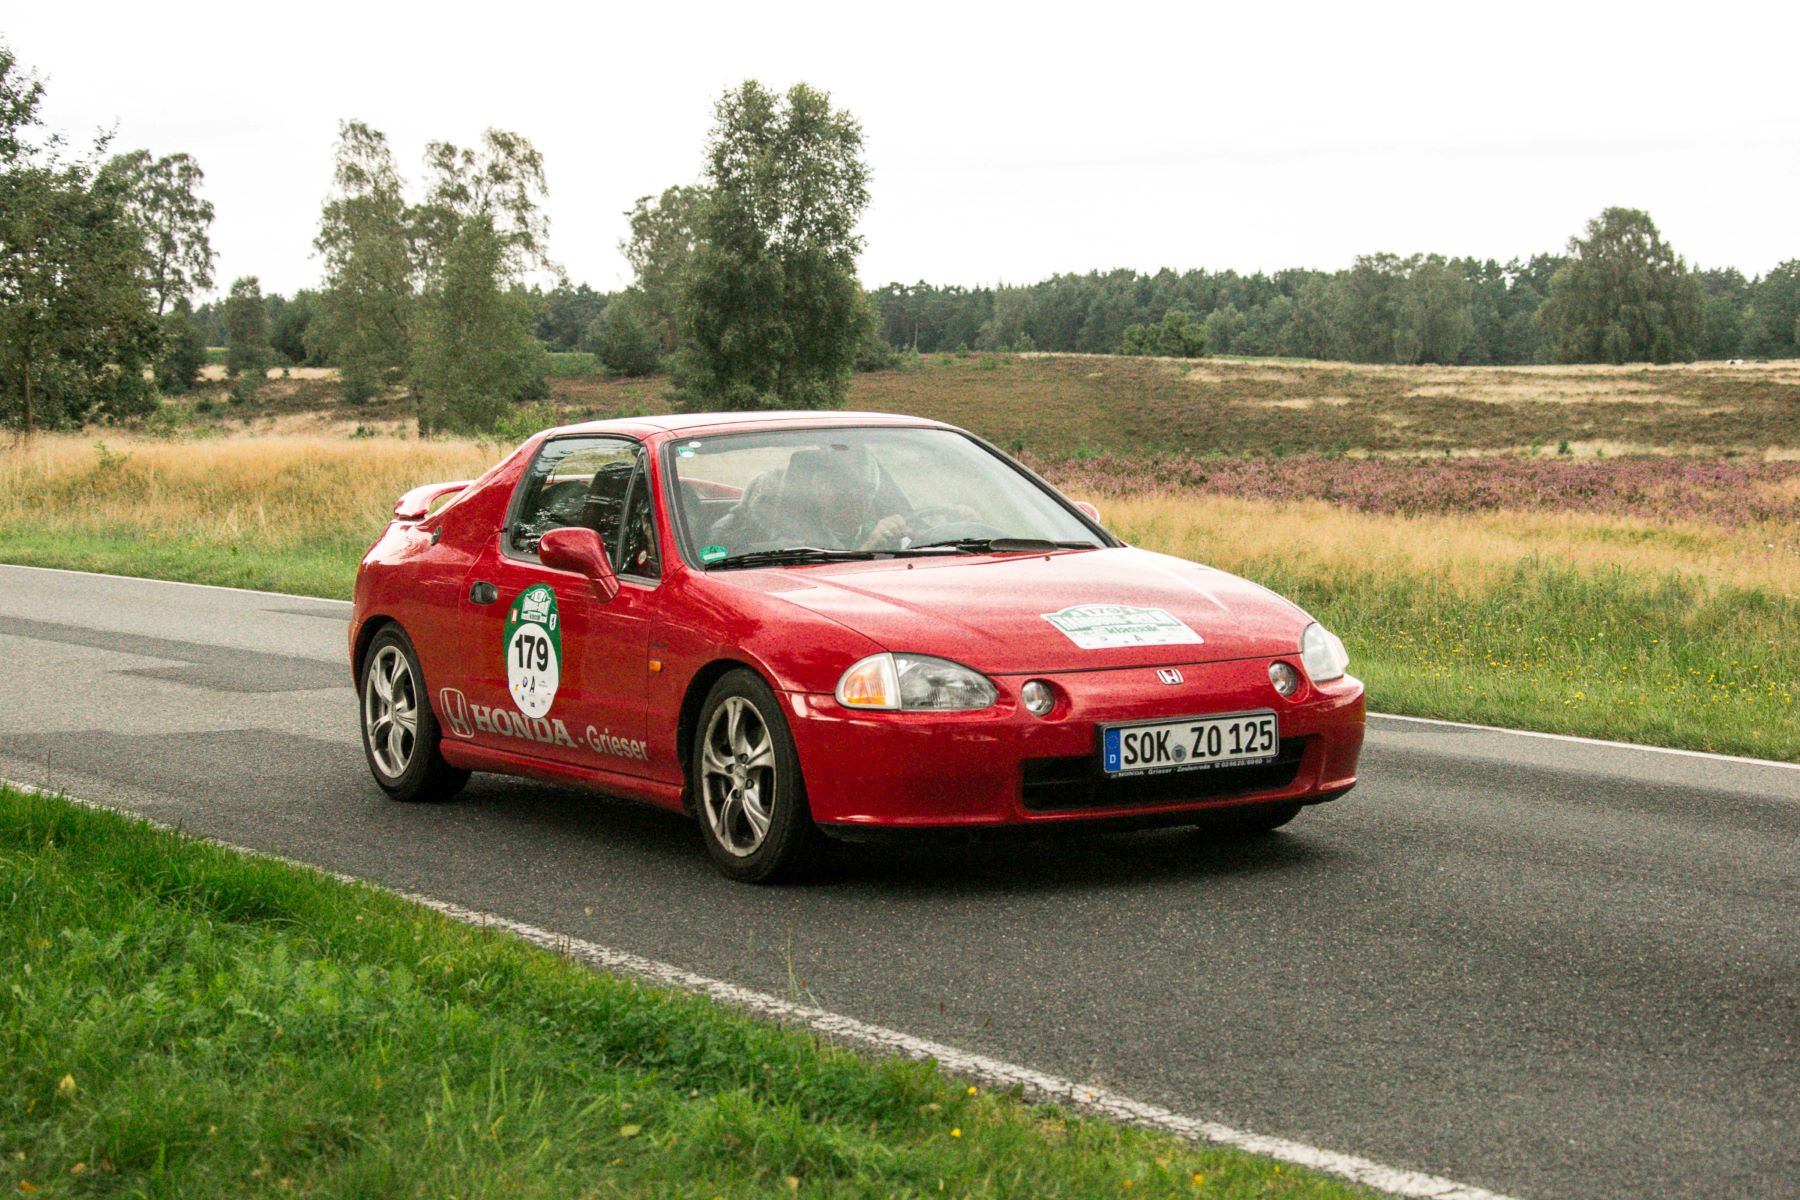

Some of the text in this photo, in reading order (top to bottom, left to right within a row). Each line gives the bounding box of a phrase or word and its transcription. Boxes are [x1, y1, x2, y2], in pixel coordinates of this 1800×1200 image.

[515, 634, 548, 671] 179
[470, 704, 578, 748] HONDA
[586, 725, 648, 761] Grieser
[1124, 719, 1273, 765] SOK ZO 125
[1109, 754, 1116, 764] D
